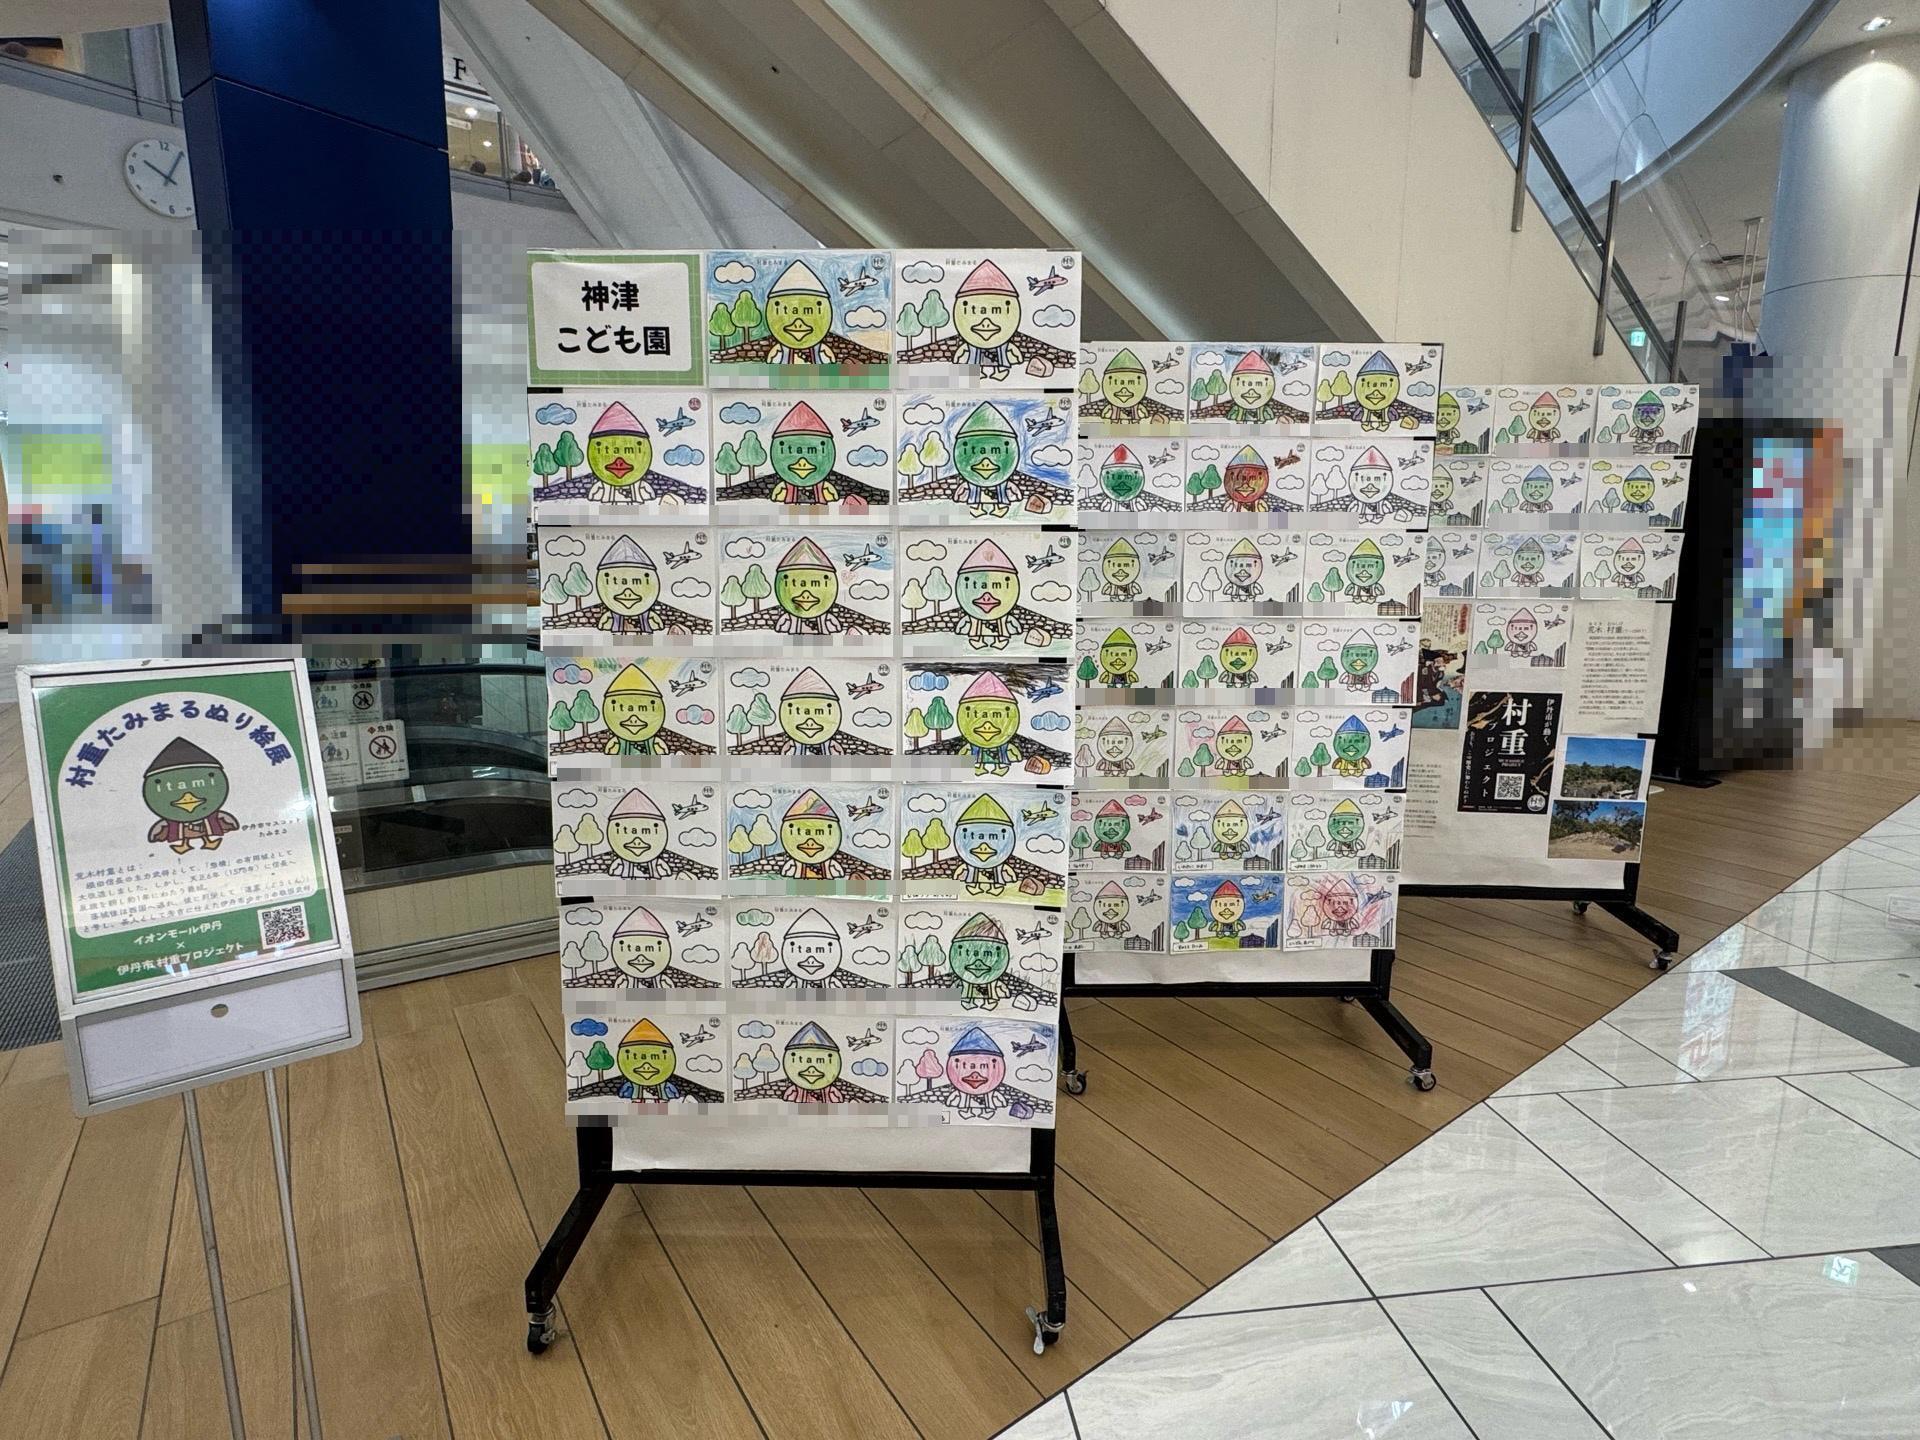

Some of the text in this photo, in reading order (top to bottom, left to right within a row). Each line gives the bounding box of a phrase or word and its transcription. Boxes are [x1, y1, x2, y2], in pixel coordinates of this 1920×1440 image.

[159, 141, 170, 151] 12
[128, 165, 135, 174] 9
[169, 205, 175, 214] 6
[581, 280, 640, 312] 神津
[775, 300, 822, 315] itami
[963, 300, 1011, 315] itami
[557, 325, 671, 356] こども園
[1109, 375, 1141, 385] itami
[1236, 377, 1268, 386] itami
[1361, 378, 1393, 388] itami
[596, 441, 642, 454] itami
[780, 441, 826, 454] itami
[963, 441, 1009, 455] itami
[1106, 470, 1138, 480] itami
[1355, 472, 1386, 481] itami
[1107, 559, 1135, 568] itami
[1230, 560, 1257, 568] itami
[1352, 560, 1379, 568] itami
[604, 573, 650, 585] itami
[783, 575, 829, 588] itami
[964, 576, 1010, 590] itami
[1105, 649, 1132, 657] itami
[1225, 648, 1252, 656] itami
[611, 699, 656, 712] itami
[788, 702, 832, 715] itami
[965, 706, 1010, 719] itami
[1498, 698, 1533, 755] 村重
[65, 700, 292, 788] 村重たみまるぬり絵展
[1102, 737, 1129, 745] itami
[1221, 736, 1247, 744] itami
[1482, 721, 1498, 798] プロジェクト
[155, 774, 216, 792] itami
[615, 823, 659, 835] itami
[1099, 819, 1125, 827] itami
[1217, 819, 1243, 827] itami
[789, 823, 833, 836] itami
[962, 828, 1006, 840] itami
[1098, 900, 1125, 908] itami
[1214, 899, 1240, 907] itami
[133, 920, 223, 945] イオンモール伊丹
[619, 940, 662, 952] itami
[790, 941, 833, 953] itami
[958, 944, 1001, 958] itami
[625, 1049, 667, 1060] itami
[791, 1052, 833, 1064] itami
[954, 1058, 997, 1070] itami
